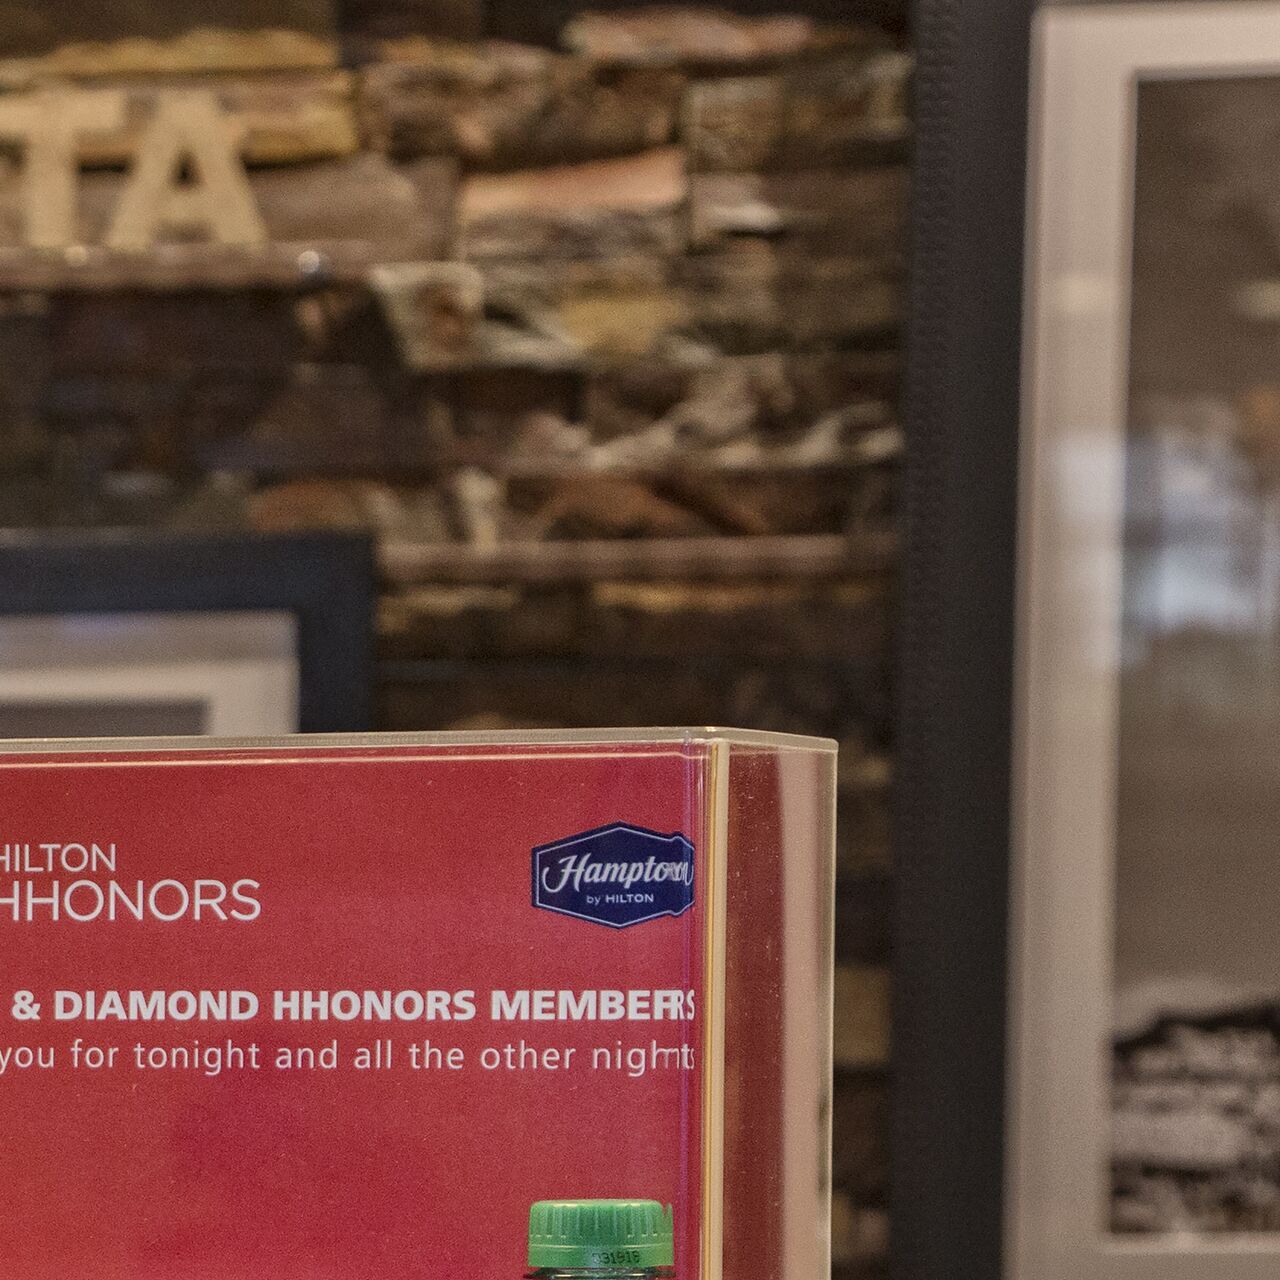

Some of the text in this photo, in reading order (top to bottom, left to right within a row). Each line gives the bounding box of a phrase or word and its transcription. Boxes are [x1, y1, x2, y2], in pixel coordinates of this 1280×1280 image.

[604, 892, 655, 905] HILTON
[12, 989, 42, 1021] &
[54, 988, 259, 1021] DIAMOND
[273, 988, 477, 1021] HHONORS
[70, 1038, 120, 1069] for
[134, 1038, 261, 1077] tonight
[273, 1039, 338, 1070] and
[353, 1039, 393, 1070] all
[408, 1039, 465, 1070] the
[480, 1039, 573, 1070] other
